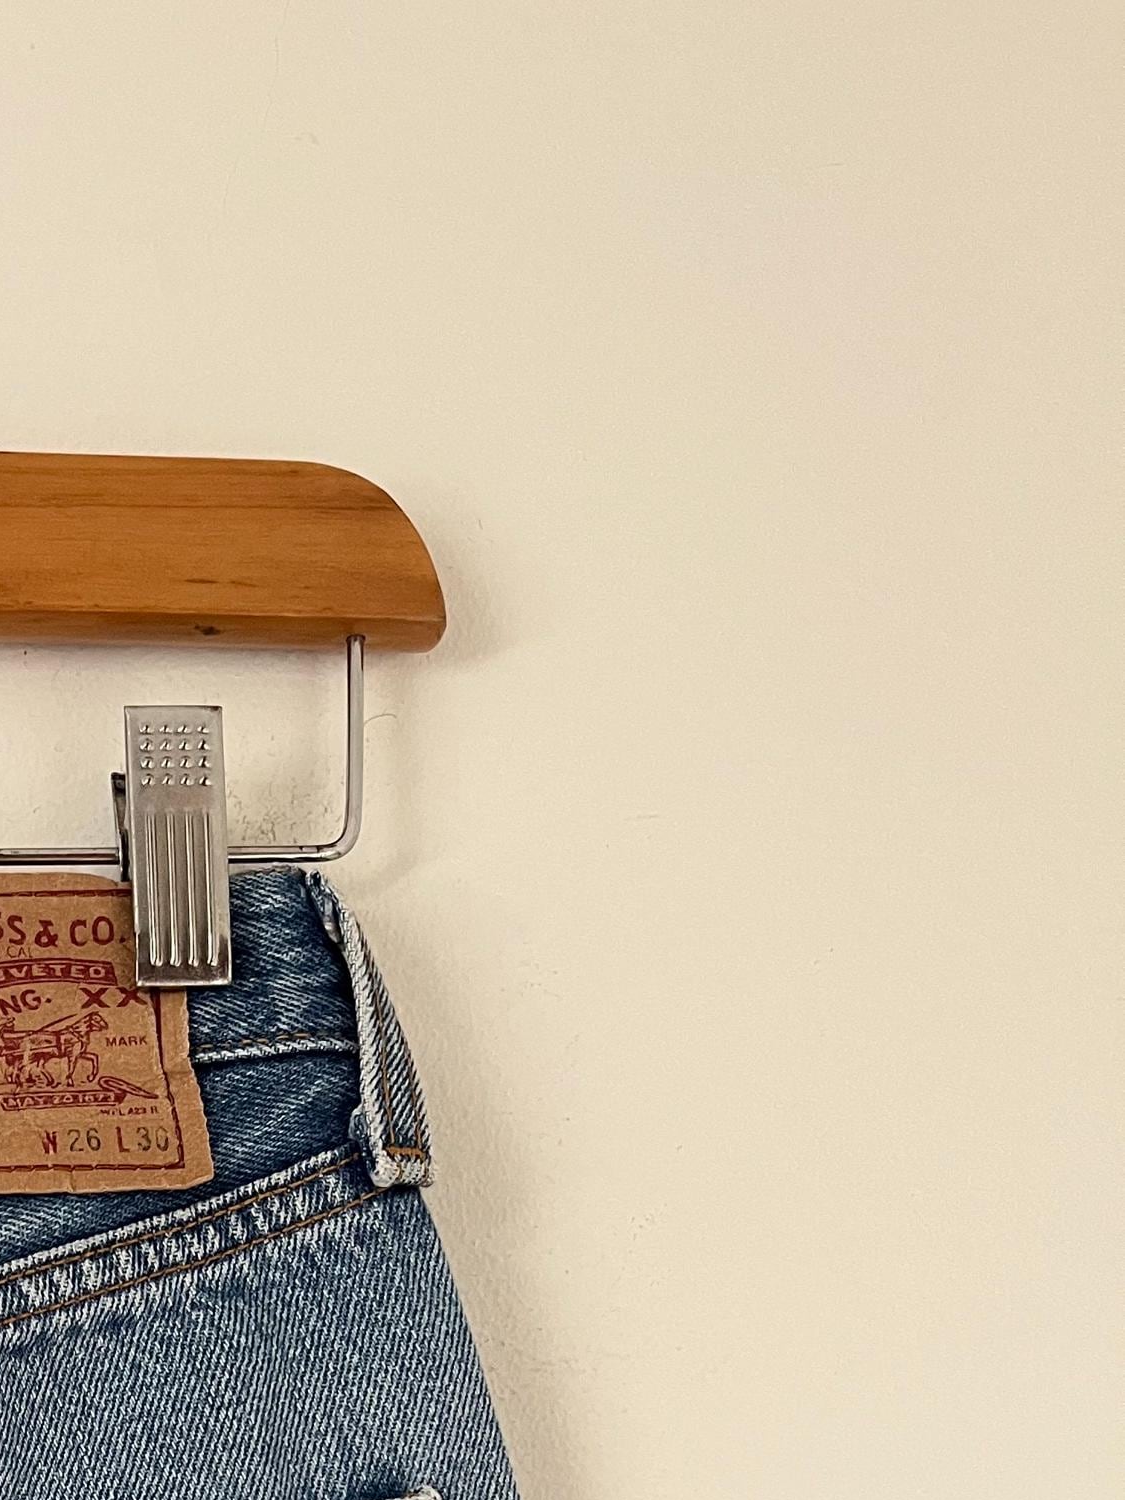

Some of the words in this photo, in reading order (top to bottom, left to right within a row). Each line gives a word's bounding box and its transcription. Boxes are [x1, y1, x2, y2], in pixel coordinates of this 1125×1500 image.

[69, 915, 126, 947] CO.
[105, 1035, 148, 1048] MARK
[7, 1096, 45, 1109] MAY
[66, 1126, 102, 1152] 26
